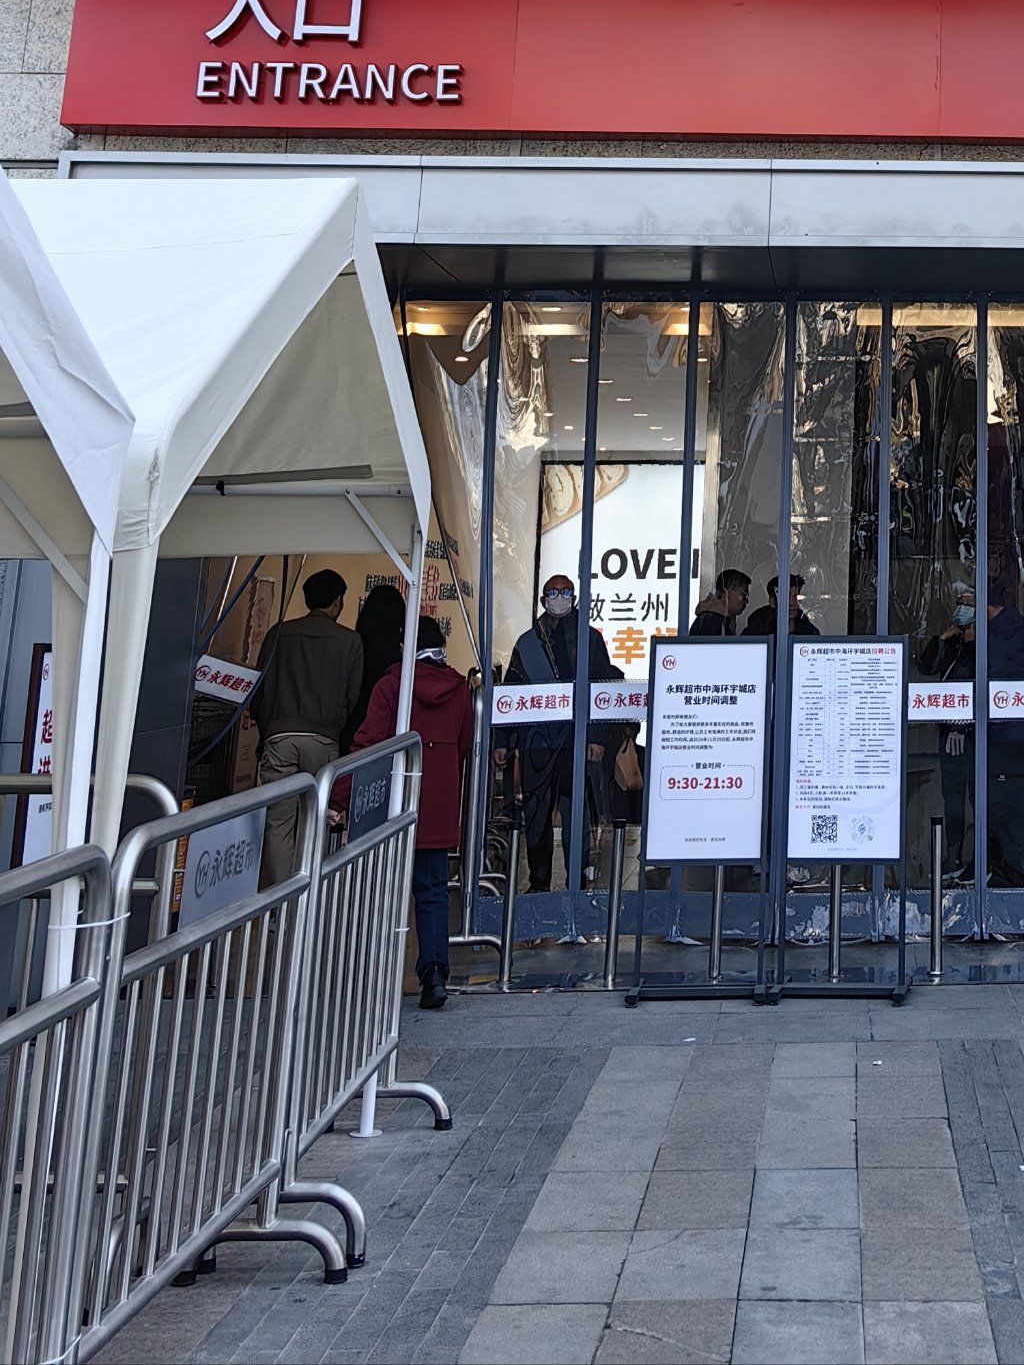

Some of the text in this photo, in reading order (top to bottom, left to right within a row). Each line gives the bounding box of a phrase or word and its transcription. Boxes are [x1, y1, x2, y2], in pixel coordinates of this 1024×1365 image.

[196, 61, 463, 102] ENTRANCE
[666, 684, 757, 694] 永辉超市中海环宇城店
[514, 693, 571, 711] 永辉超市
[683, 695, 738, 705] 营业时间调整
[911, 693, 970, 709] 永辉超市
[667, 777, 743, 790] 9:30-21:30
